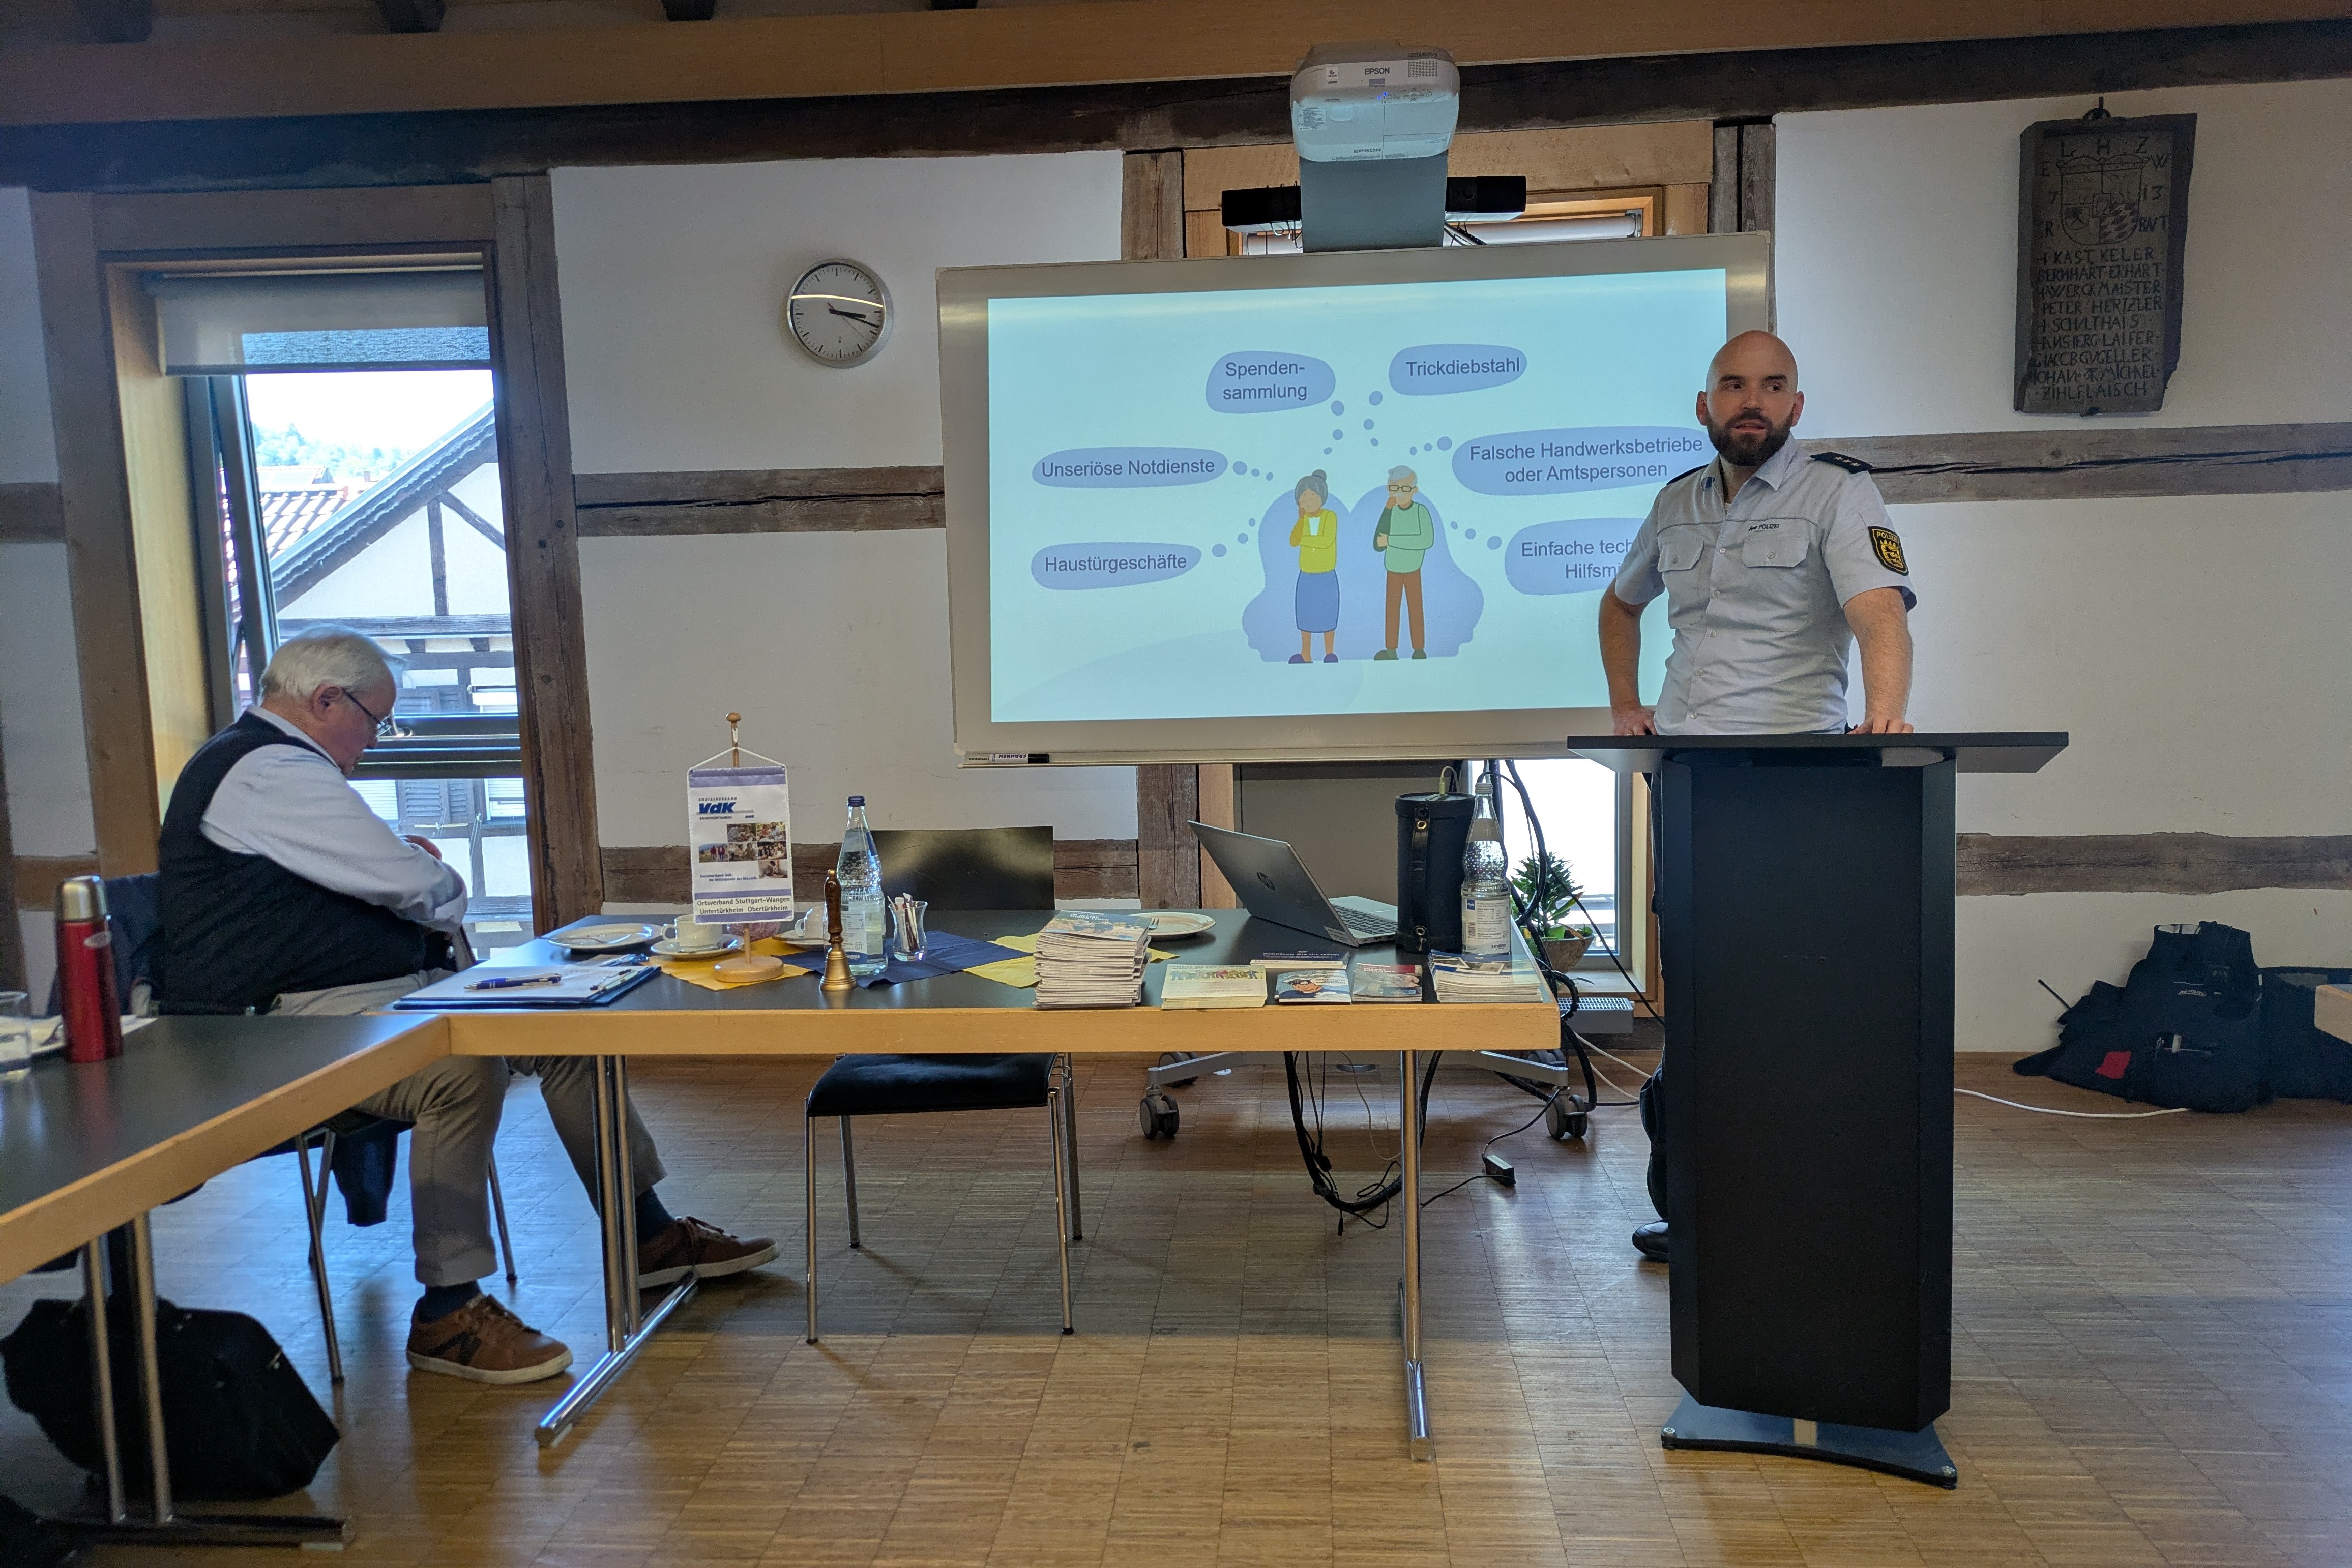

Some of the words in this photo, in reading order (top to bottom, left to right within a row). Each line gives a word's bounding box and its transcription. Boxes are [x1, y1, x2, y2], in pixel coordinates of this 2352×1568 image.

[2043, 300, 2082, 314] PETER
[1225, 360, 1305, 380] Spenden-
[1405, 357, 1520, 376] Trickdiebstahl
[1222, 383, 1308, 401] sammlung
[1470, 443, 1535, 460] Falsche
[1541, 437, 1703, 458] Handwerksbetriebe
[1042, 461, 1123, 477] Unseriöse
[1128, 458, 1215, 475] Notdienste
[1505, 466, 1543, 482] oder
[1546, 463, 1668, 482] Amtspersonen
[1521, 540, 1594, 557] Einfache
[1599, 538, 1633, 554] tech
[1045, 554, 1187, 574] Haustürgeschäfte
[698, 802, 737, 814] VdK
[735, 897, 790, 905] Stuttgart-Wangen
